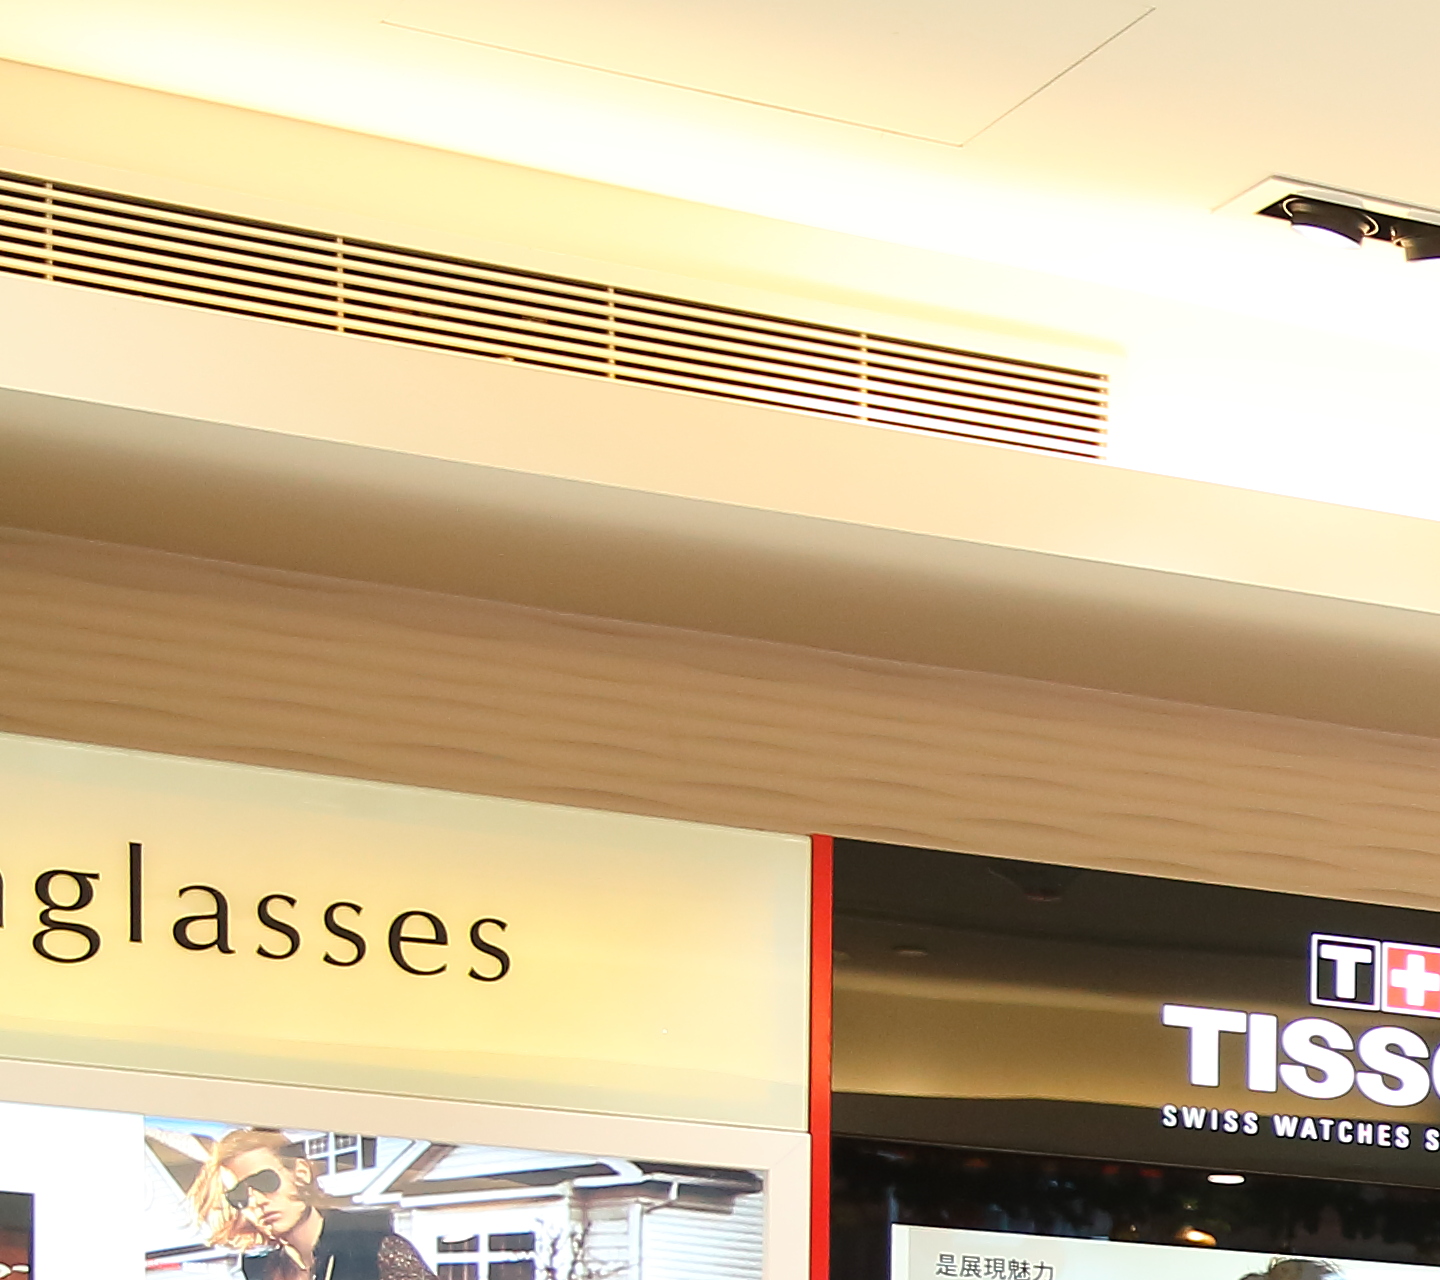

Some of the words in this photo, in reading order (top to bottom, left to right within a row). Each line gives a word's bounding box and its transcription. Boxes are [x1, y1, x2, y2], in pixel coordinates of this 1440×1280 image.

[0, 841, 512, 984] glasses
[1161, 1104, 1260, 1136] SWISS
[1273, 1114, 1411, 1150] WATCHES
